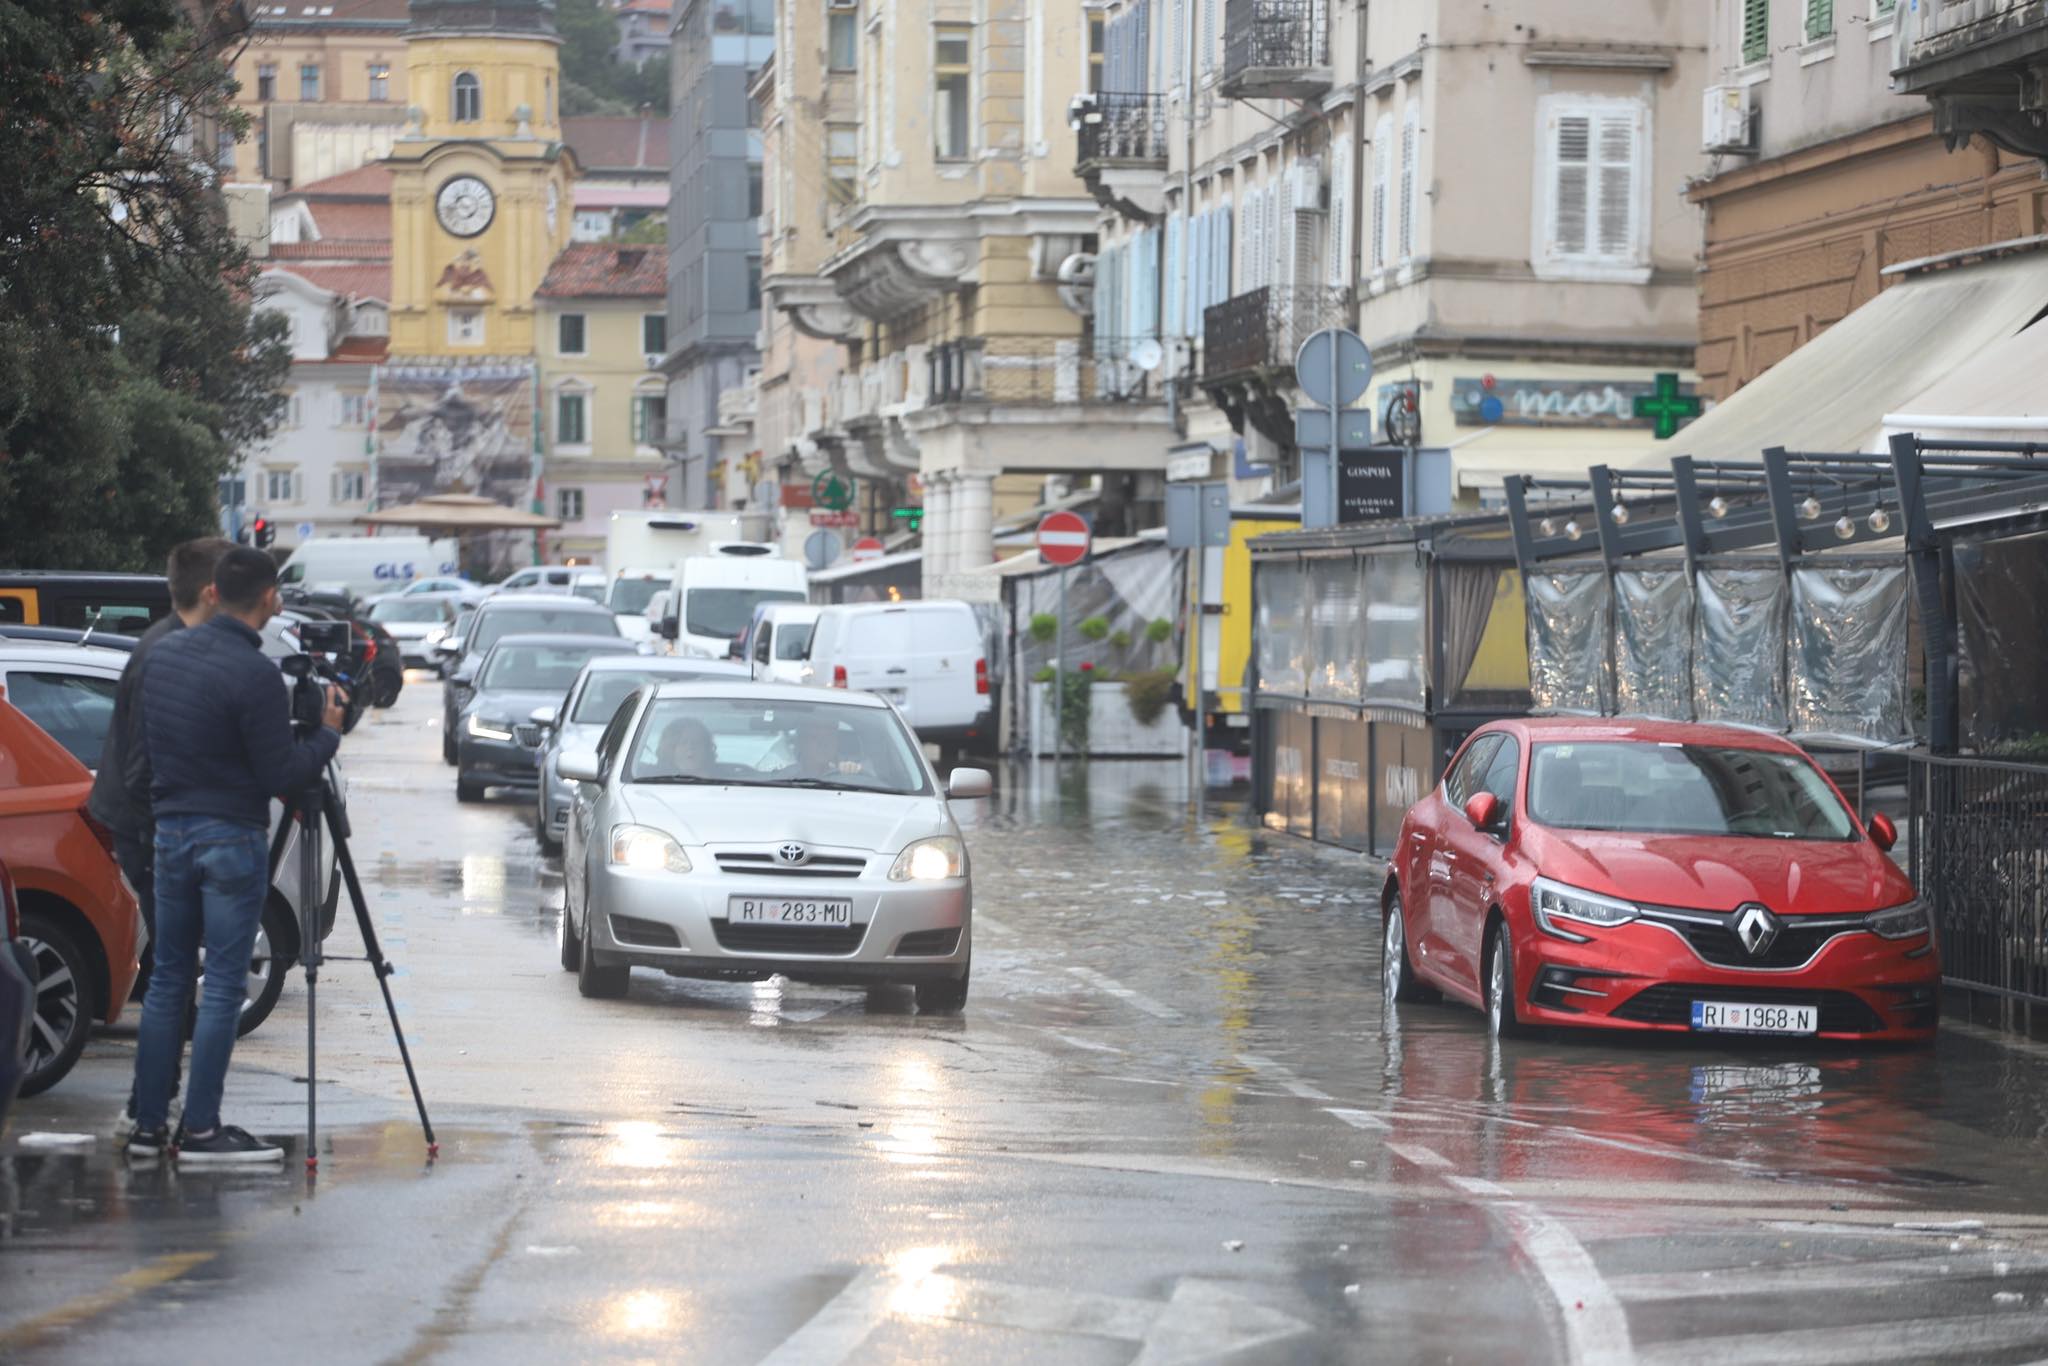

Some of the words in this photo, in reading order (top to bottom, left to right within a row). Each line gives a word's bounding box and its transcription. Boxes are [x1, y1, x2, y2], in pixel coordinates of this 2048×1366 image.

[373, 562, 415, 579] GLS
[743, 901, 764, 920] RI
[781, 902, 848, 923] 283-MU
[1705, 1006, 1725, 1026] RI
[1744, 1007, 1810, 1030] 1968-N
